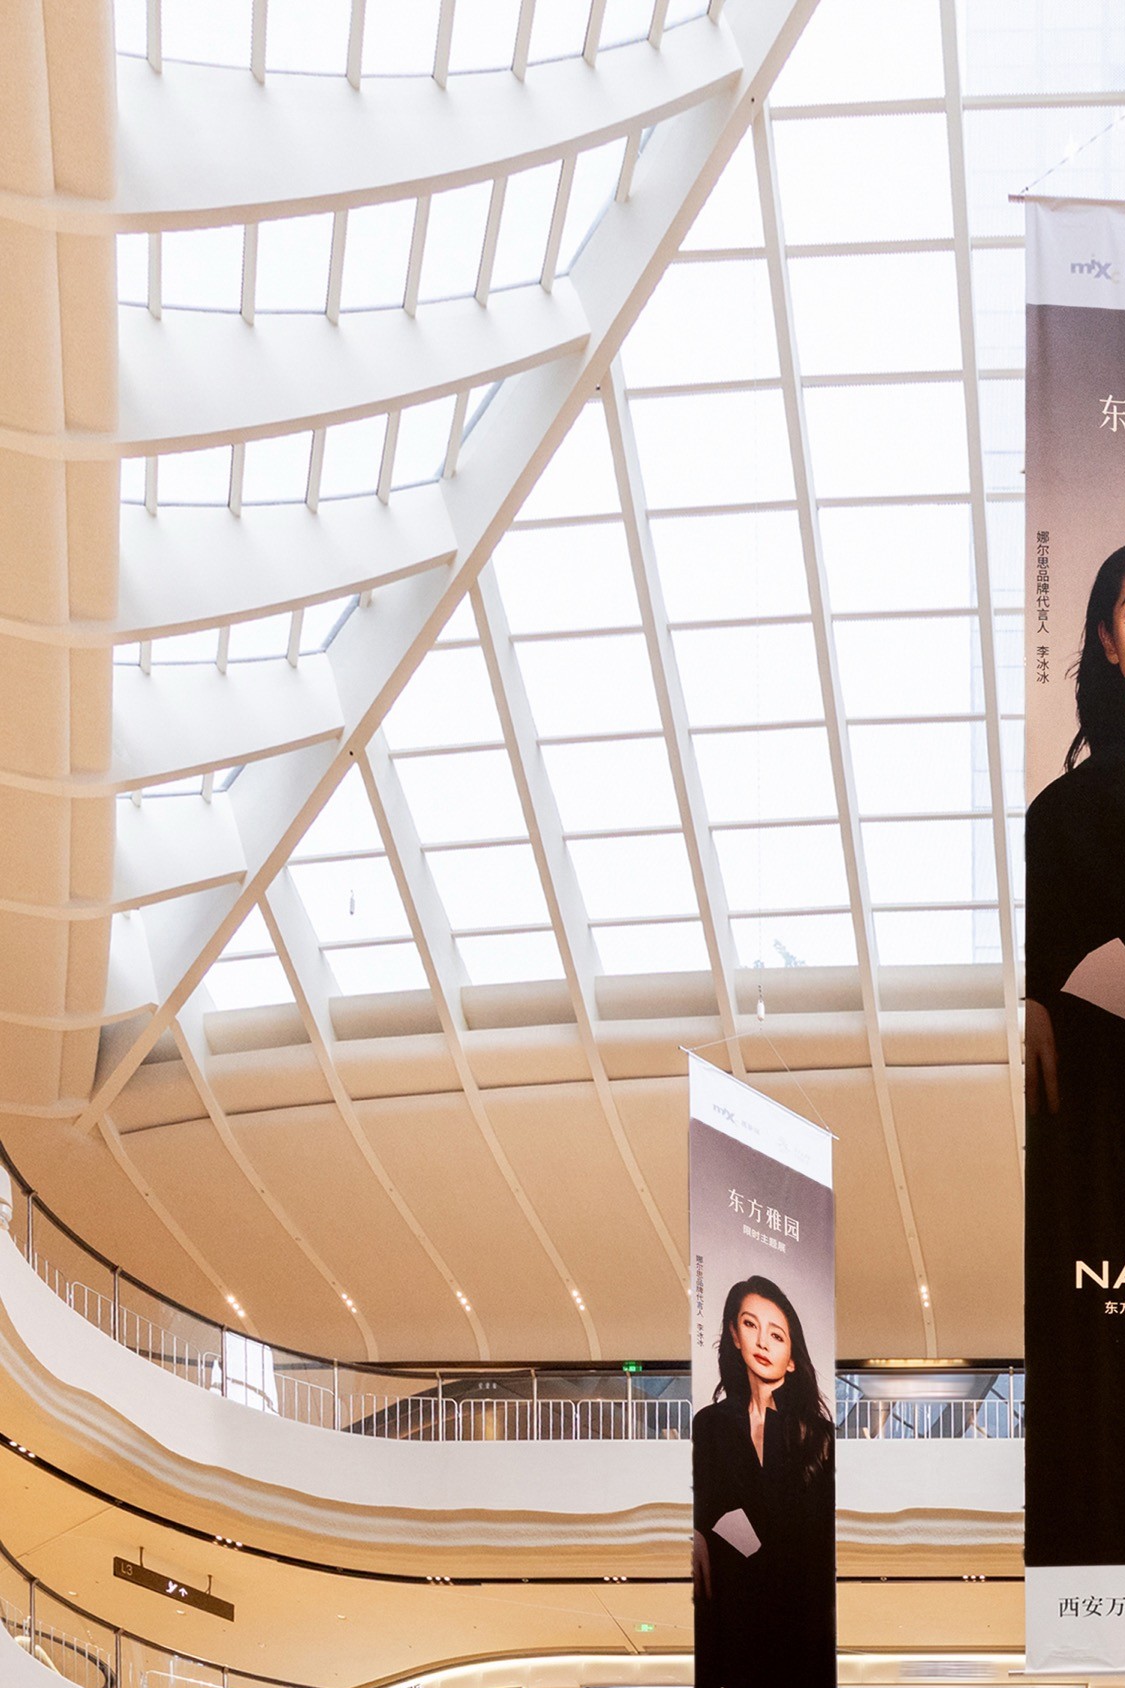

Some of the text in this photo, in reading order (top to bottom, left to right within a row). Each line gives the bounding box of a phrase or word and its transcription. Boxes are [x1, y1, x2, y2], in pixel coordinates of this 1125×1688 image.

[1036, 531, 1050, 685] 娜尔思品牌代言人 李冰冰
[728, 1188, 800, 1242] 东方雅园
[121, 1562, 133, 1576] L3
